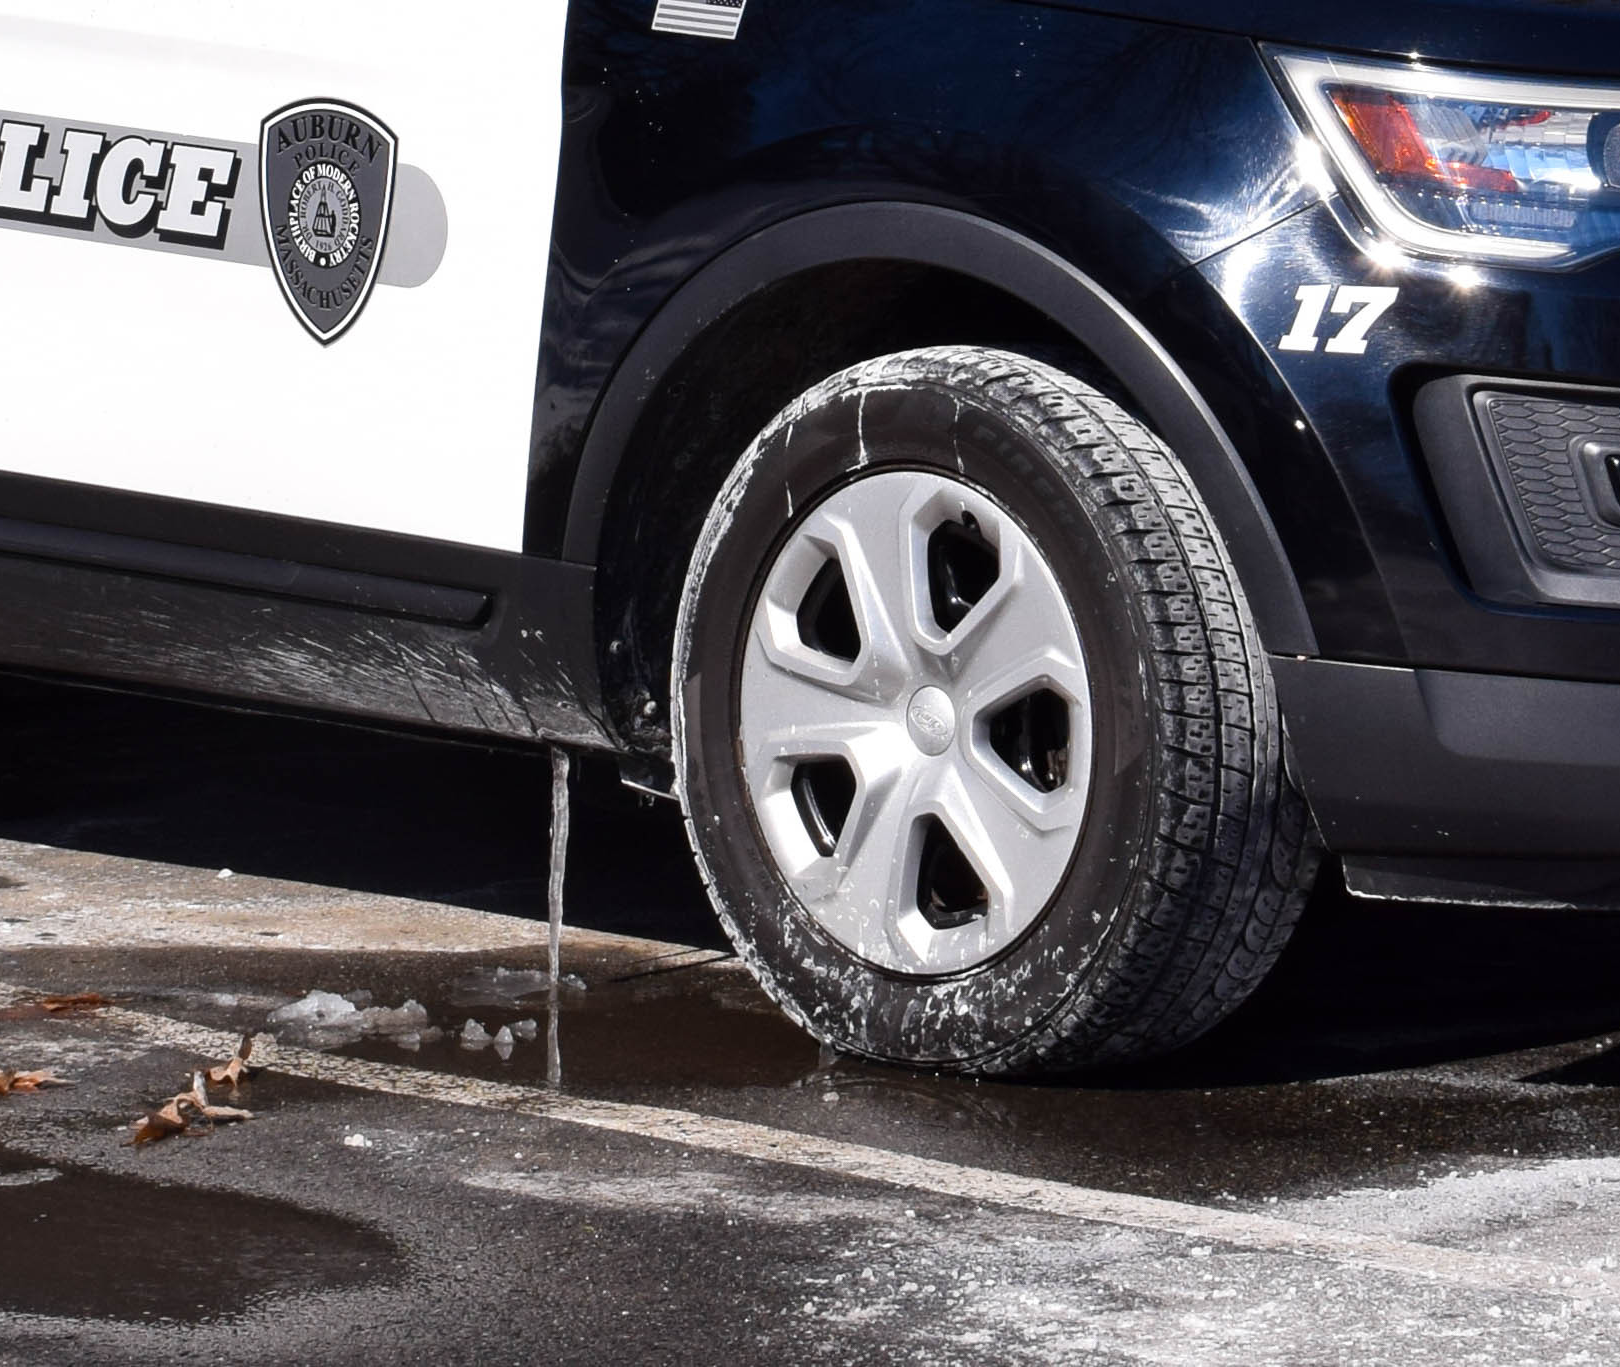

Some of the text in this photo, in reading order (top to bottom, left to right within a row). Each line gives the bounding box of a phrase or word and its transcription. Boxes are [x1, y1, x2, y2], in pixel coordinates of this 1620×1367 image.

[277, 114, 383, 164] AUBURN
[293, 142, 360, 178] POLICE
[289, 163, 360, 267] BIRTHPLACE OF MODERN ROCKETRY
[275, 225, 374, 310] MASSACHUSETTS
[1278, 284, 1400, 354] 17
